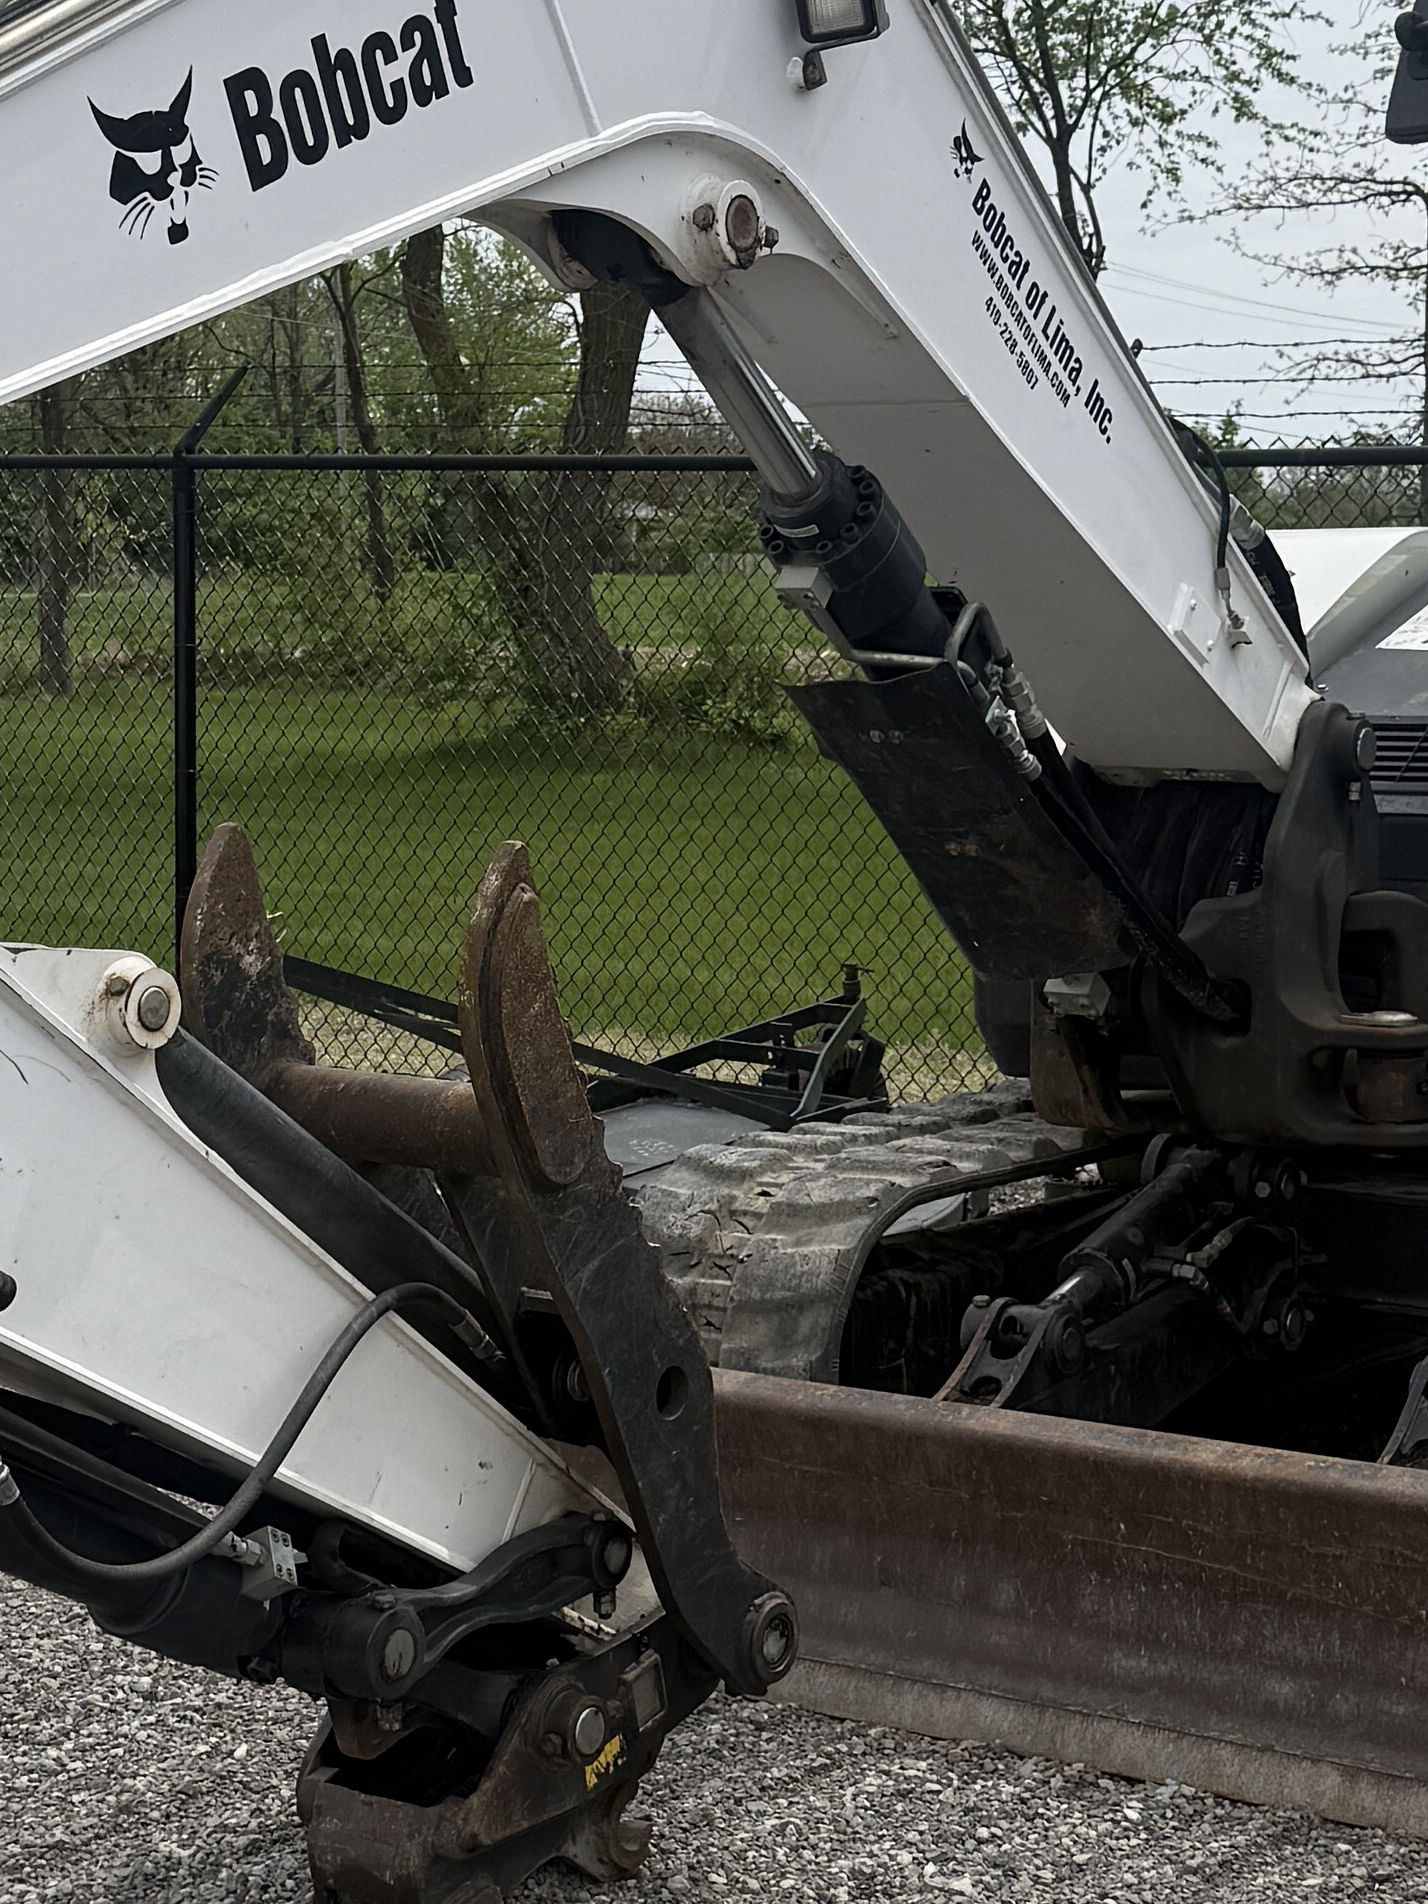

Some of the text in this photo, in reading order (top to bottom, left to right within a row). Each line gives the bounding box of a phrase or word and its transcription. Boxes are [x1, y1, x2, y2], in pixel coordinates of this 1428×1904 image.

[971, 230, 1072, 408] WWW.BOBCATOFLIMA.COM
[972, 178, 1113, 445] Bobcat of Lima, Inc.
